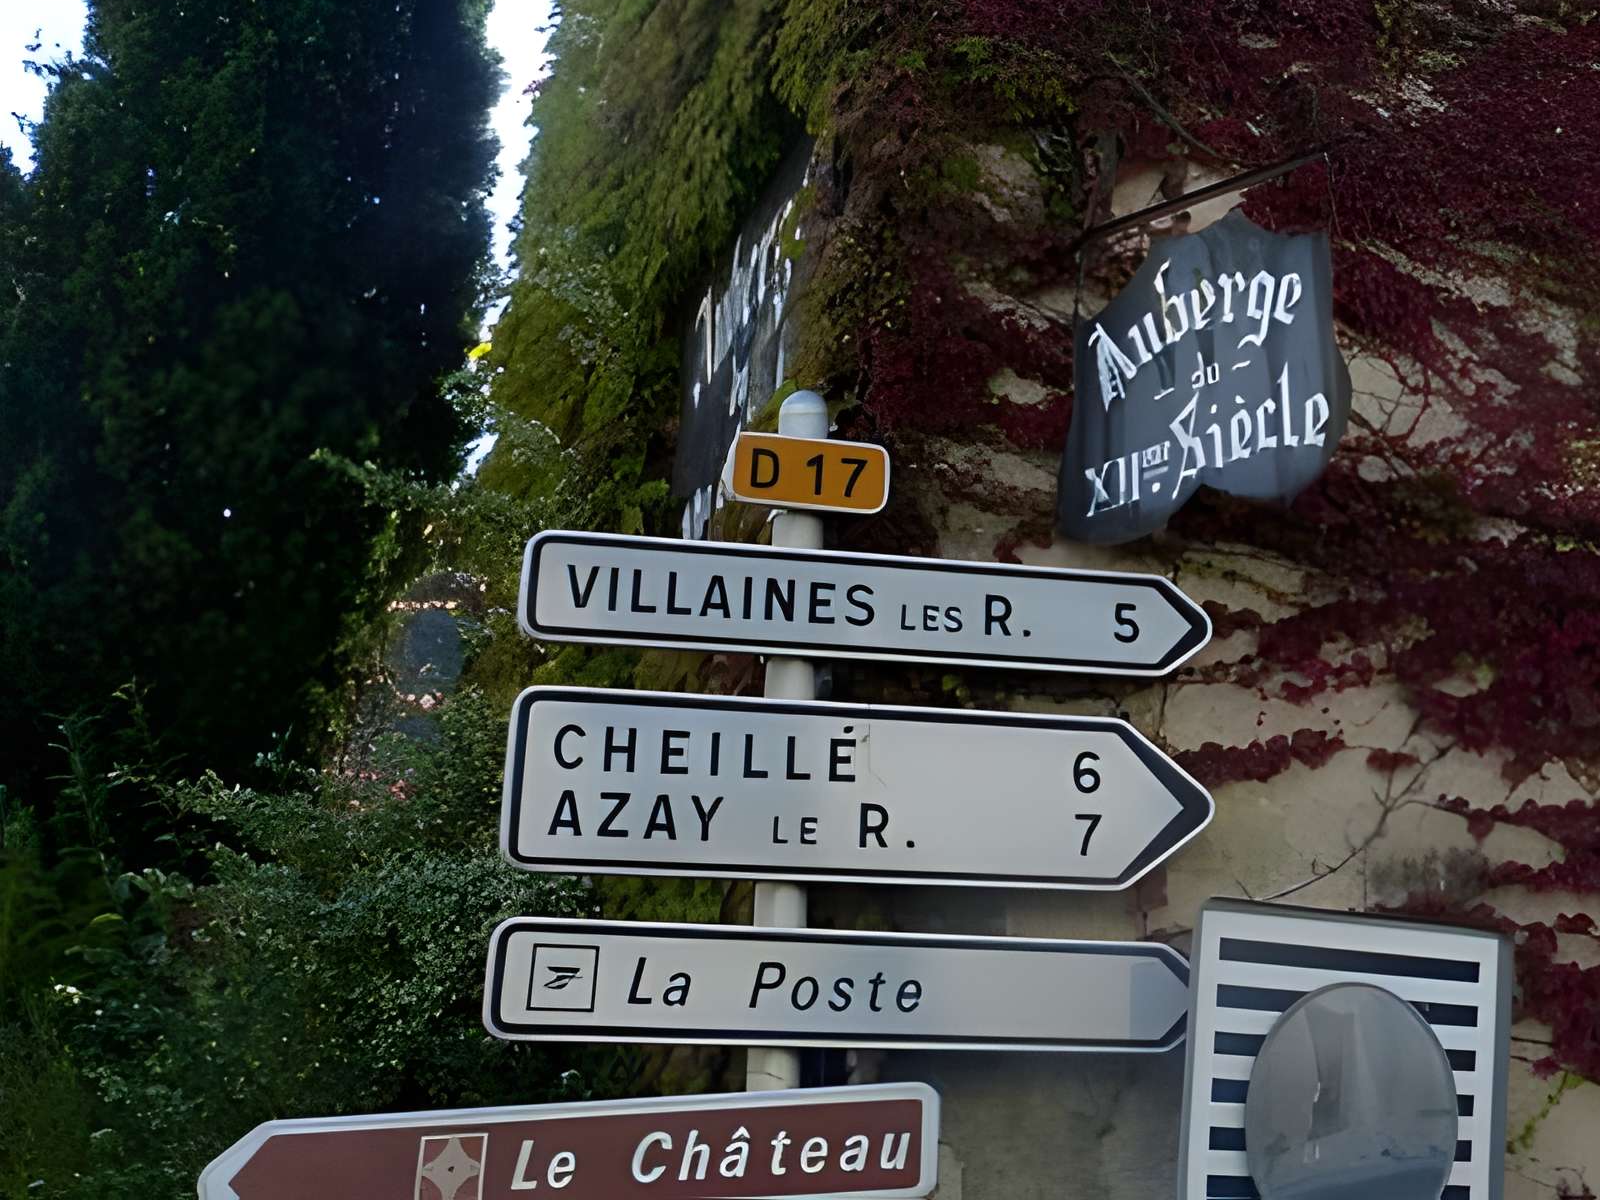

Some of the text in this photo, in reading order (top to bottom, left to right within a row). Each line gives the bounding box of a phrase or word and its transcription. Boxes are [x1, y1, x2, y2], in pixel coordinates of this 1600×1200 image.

[1087, 257, 1302, 412] Auberge
[1168, 360, 1330, 500] Siècle
[747, 445, 870, 502] D 17
[566, 563, 1141, 645] VILLAINES LES R. 5
[552, 722, 1102, 795] CHEILLÉ 6
[546, 788, 1104, 858] AZAY LE R. 7
[626, 955, 924, 1015] La Poste
[509, 1125, 912, 1191] Le Château
